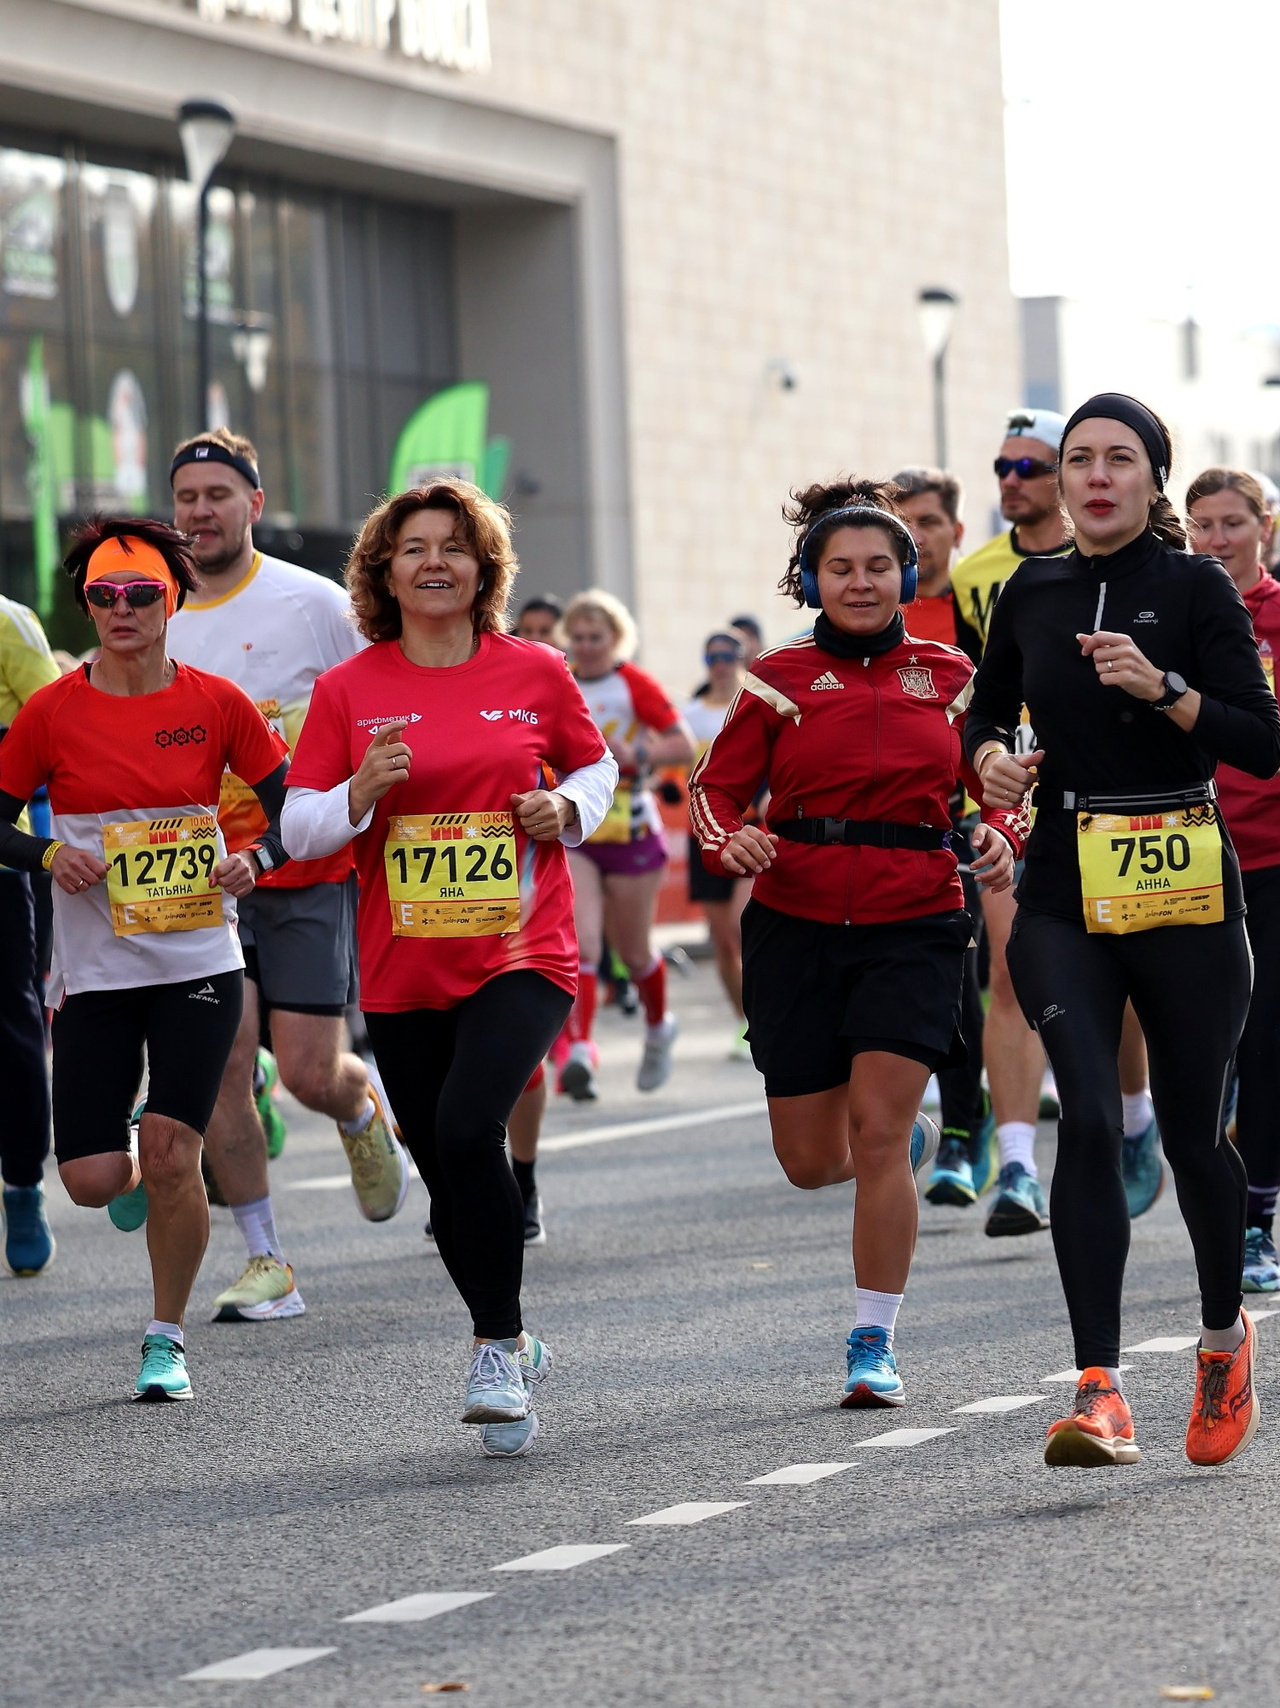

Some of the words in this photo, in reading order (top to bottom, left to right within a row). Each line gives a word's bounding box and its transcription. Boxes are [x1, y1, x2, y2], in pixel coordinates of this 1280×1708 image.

[810, 682, 845, 691] adidas
[508, 709, 539, 725] МКБ
[392, 844, 513, 884] 17126
[1111, 834, 1191, 877] 750
[113, 844, 216, 888] 12739
[146, 884, 193, 898] ТАТЬЯНА
[440, 887, 464, 897] ЯНА
[1136, 877, 1171, 891] АННА
[401, 903, 414, 926] E
[1096, 900, 1113, 923] E
